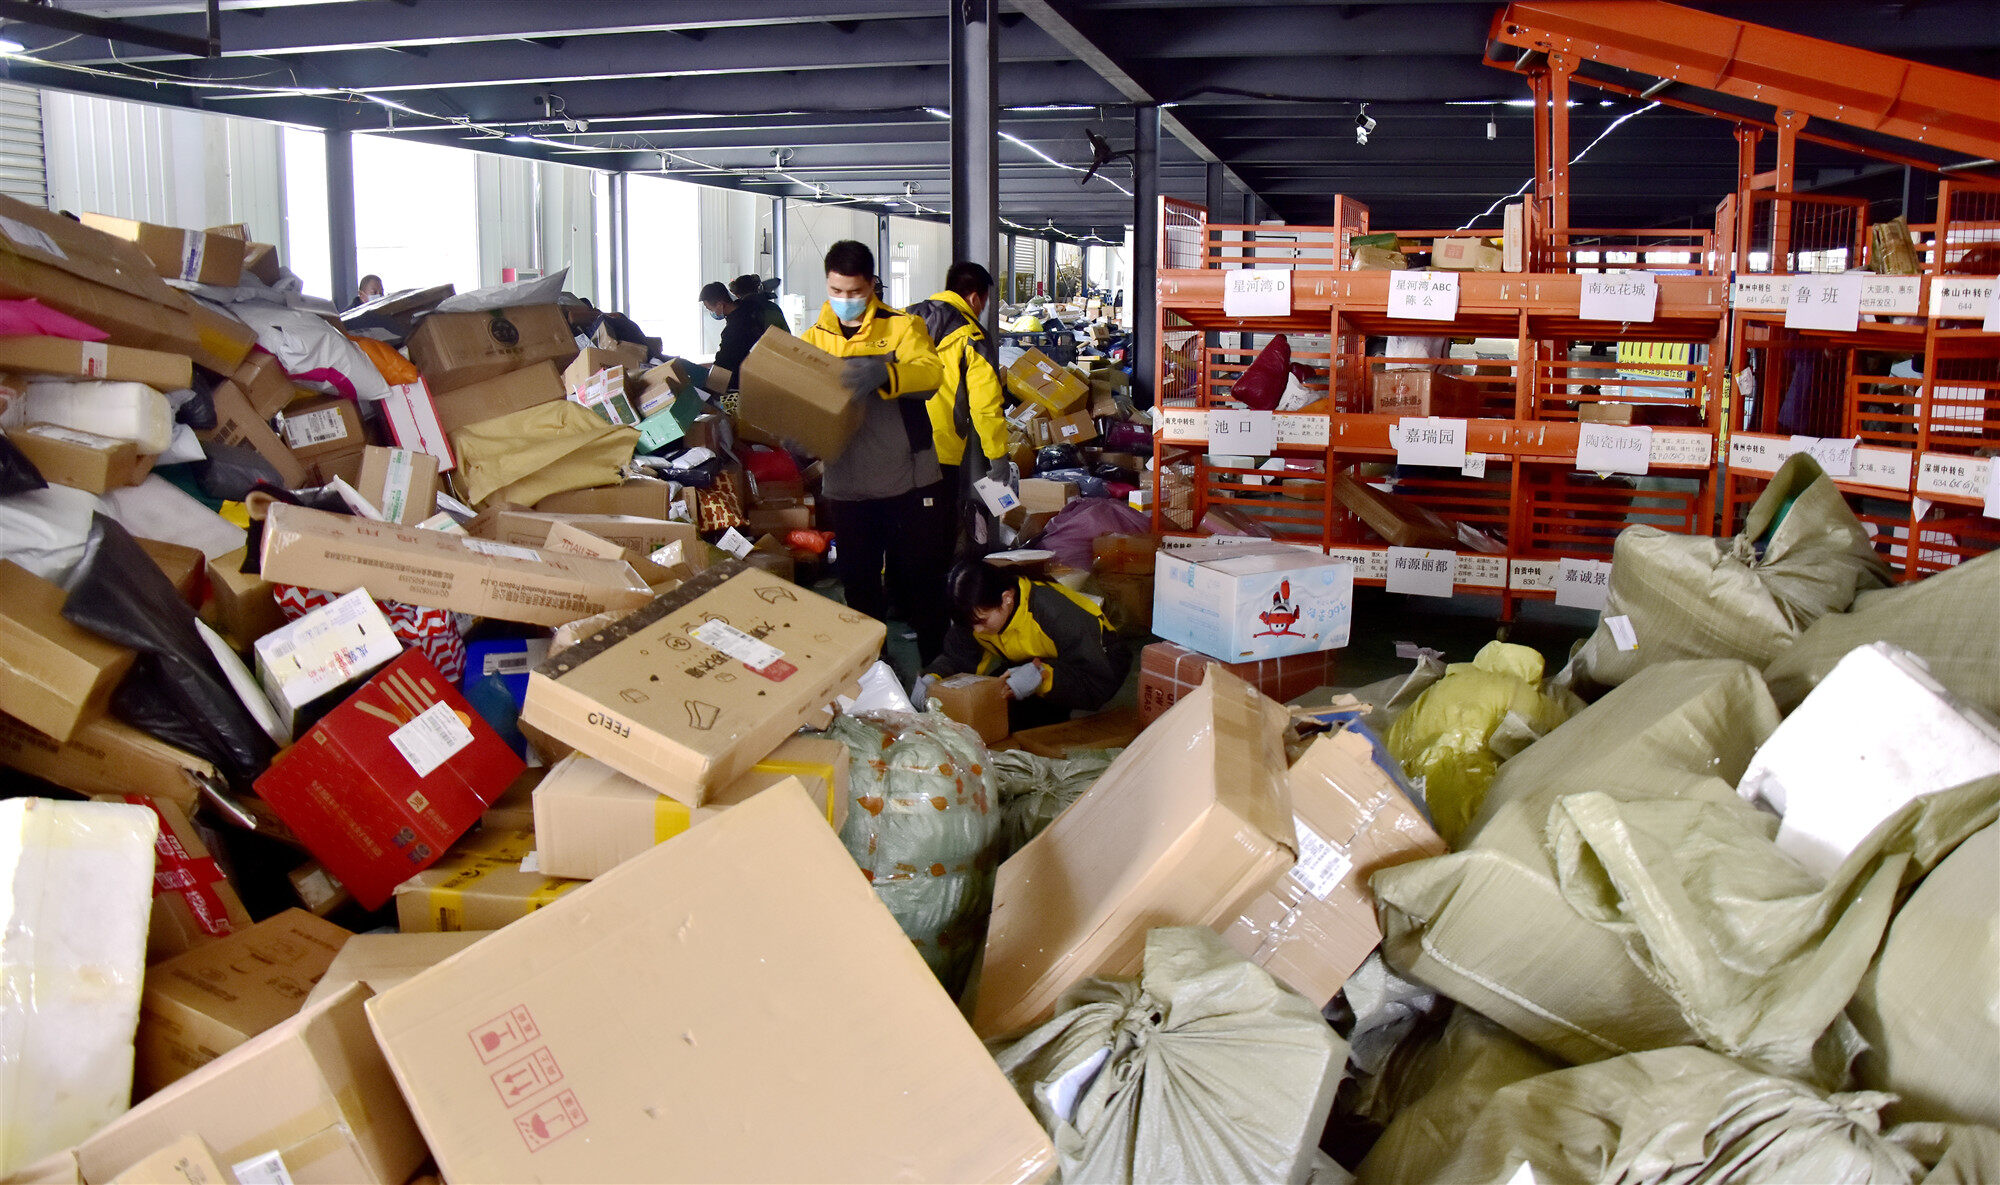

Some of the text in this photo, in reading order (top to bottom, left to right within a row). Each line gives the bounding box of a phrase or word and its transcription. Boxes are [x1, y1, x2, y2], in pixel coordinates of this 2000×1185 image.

[1233, 279, 1285, 293] 星河湾 D
[1396, 280, 1452, 292] 星河湾 ABC
[1589, 282, 1646, 296] 南苑花城
[1941, 287, 1992, 298] 佛山中转包
[1423, 295, 1433, 306] 公
[1797, 286, 1811, 303] 鲁
[1821, 287, 1839, 304] 班
[1958, 302, 1972, 310] 644
[1215, 420, 1251, 434] 池 口
[1406, 428, 1454, 445] 嘉瑞园
[1585, 434, 1642, 452] 陶瓷市场
[1733, 442, 1766, 455] 梅州中转包
[1924, 463, 1965, 476] 深圳中转包
[1395, 556, 1448, 573] 南源丽都
[1565, 568, 1607, 585] 嘉诚景
[587, 711, 631, 739] FEELO
